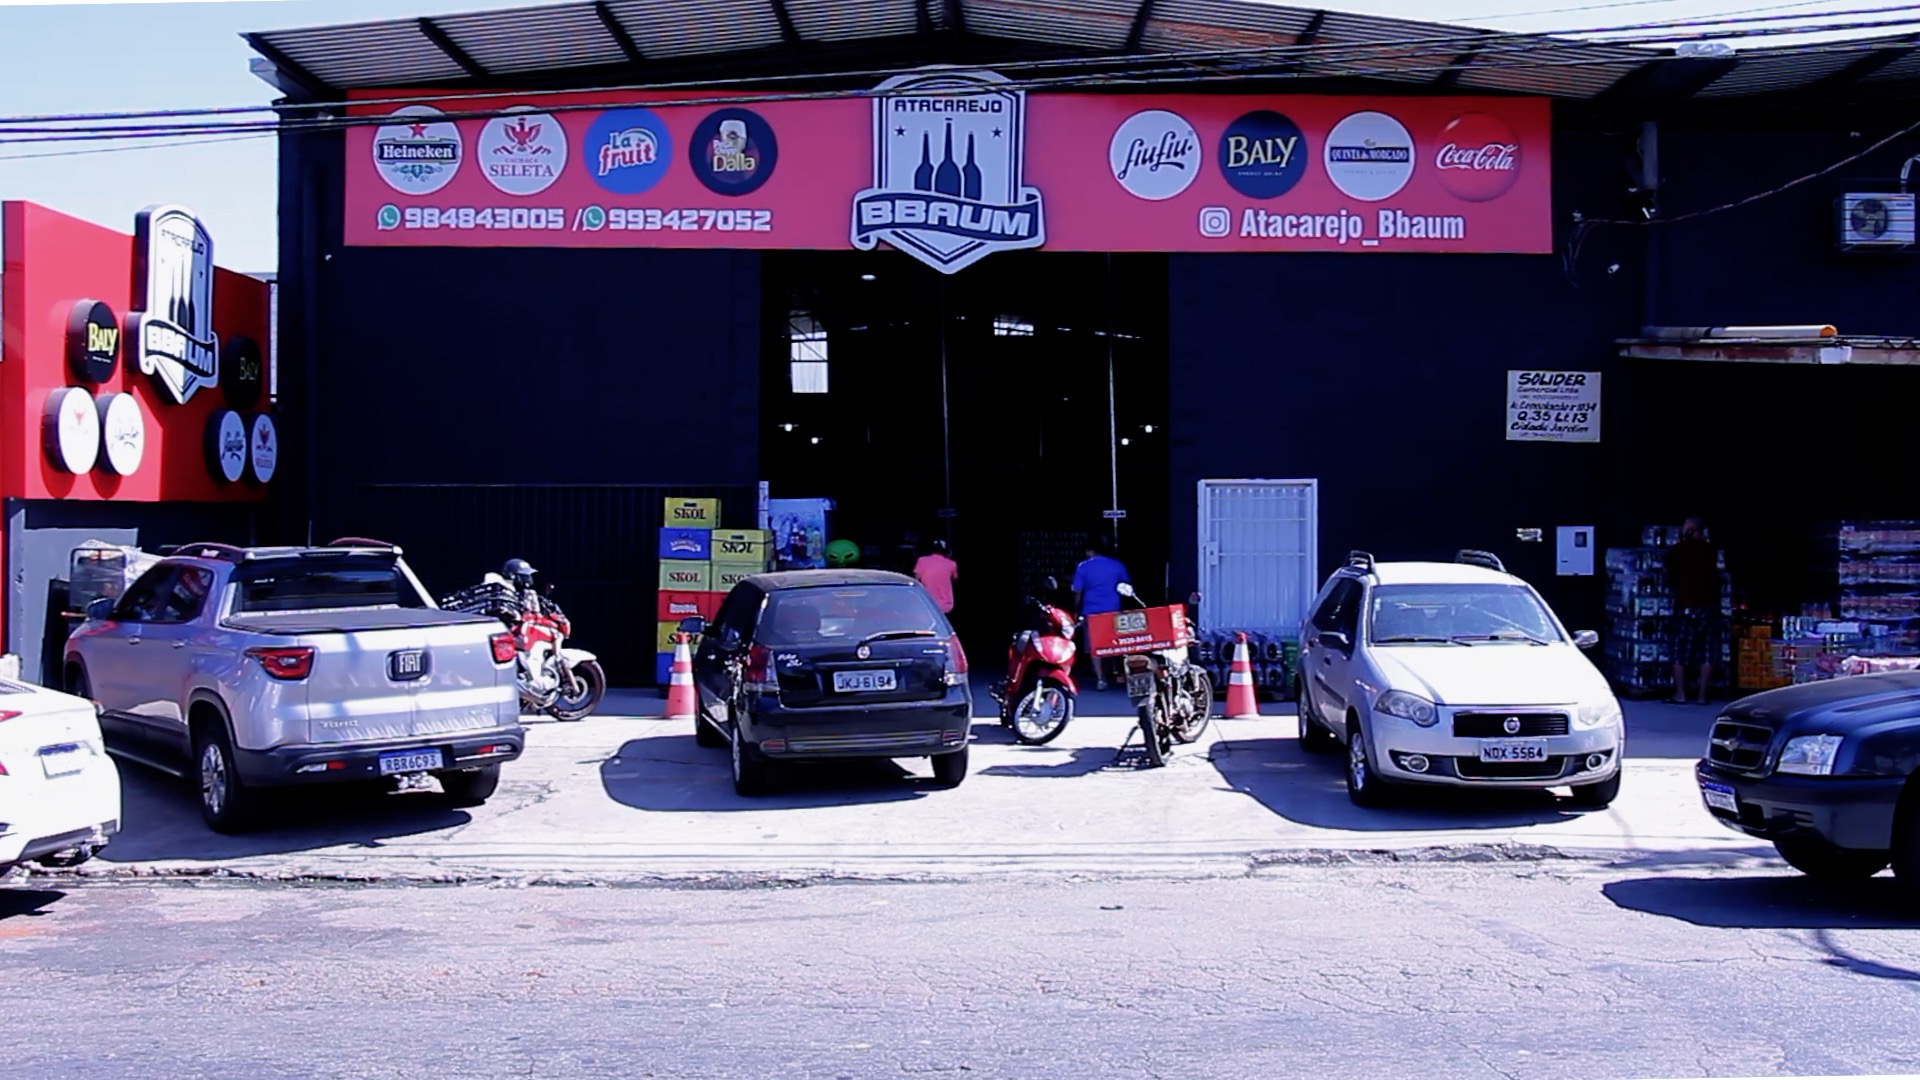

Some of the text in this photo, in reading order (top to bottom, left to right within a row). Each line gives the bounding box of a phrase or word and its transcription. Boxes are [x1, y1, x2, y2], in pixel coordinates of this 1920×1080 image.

[894, 99, 1002, 113] ATACAREJO
[611, 133, 632, 149] La
[382, 145, 454, 159] Heineken
[599, 144, 656, 176] fruit
[1226, 136, 1299, 168] BALY
[1436, 143, 1518, 170] Coca-Cola
[489, 164, 555, 177] SELETA
[712, 152, 756, 172] Dalla
[404, 207, 565, 230] 984843005
[608, 208, 772, 232] 993427052
[859, 199, 1032, 237] BBAUM
[1239, 208, 1465, 247] Atacarejo_Bbaum
[146, 324, 213, 375] BBAUM
[1517, 372, 1587, 386] SOLIDER
[673, 508, 707, 520] SKOL
[720, 541, 754, 554] SKOL
[668, 571, 701, 583] SKOL
[399, 653, 421, 673] FIAT
[385, 754, 437, 771] RBR6C93
